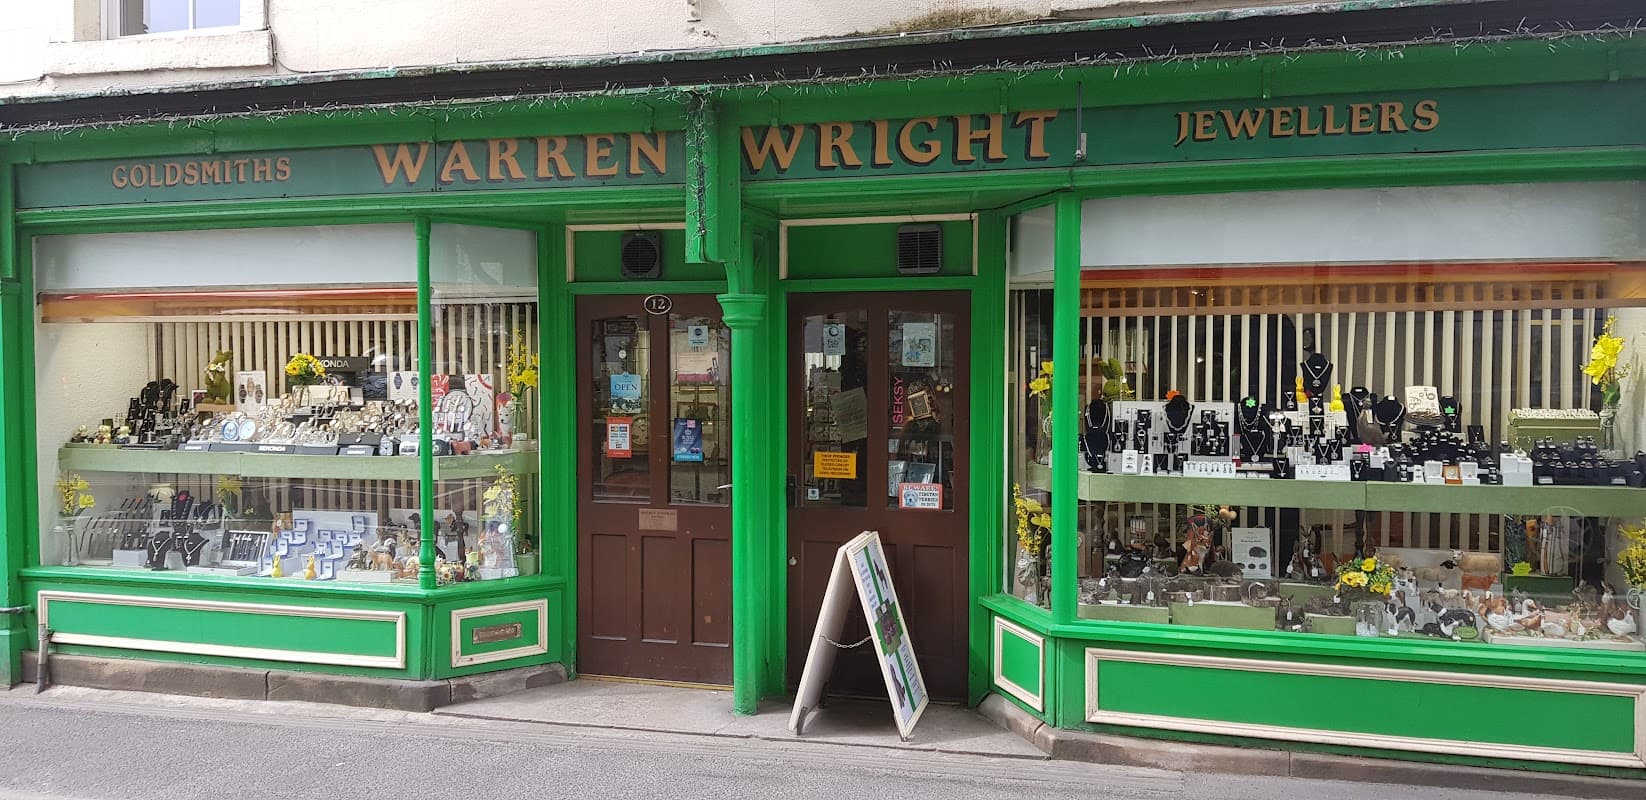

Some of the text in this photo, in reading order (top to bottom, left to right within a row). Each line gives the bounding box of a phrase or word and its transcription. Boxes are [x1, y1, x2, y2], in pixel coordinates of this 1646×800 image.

[1174, 99, 1440, 147] JEWELLERS
[373, 109, 1059, 185] WARREN WRIGHT
[111, 157, 292, 189] GOLDSMITHS
[651, 298, 666, 310] 12
[614, 383, 638, 391] OPEN
[892, 376, 904, 424] SEKSY
